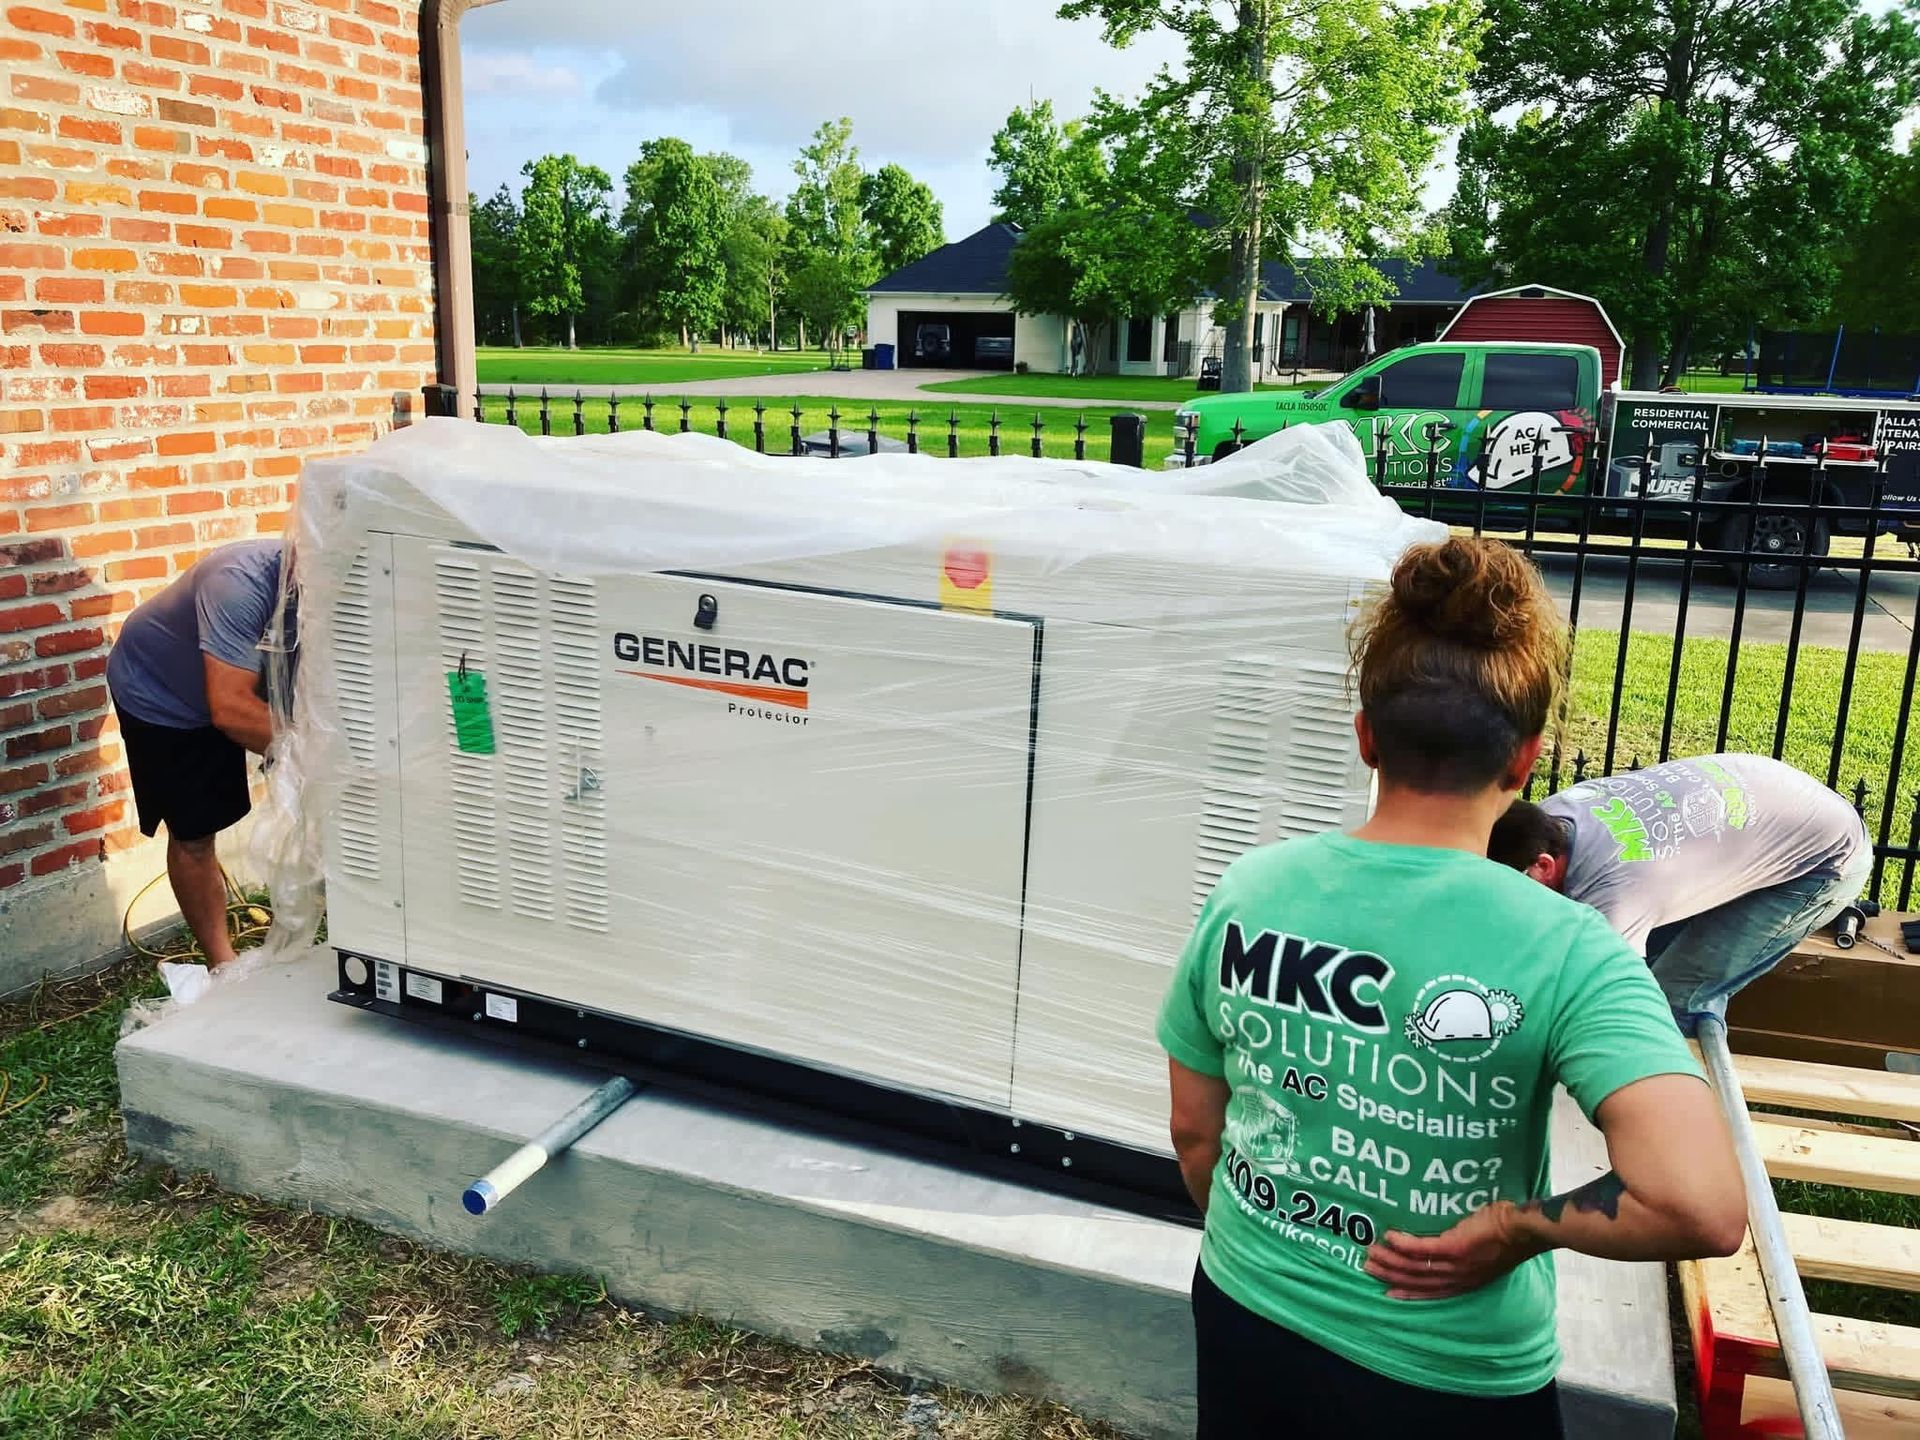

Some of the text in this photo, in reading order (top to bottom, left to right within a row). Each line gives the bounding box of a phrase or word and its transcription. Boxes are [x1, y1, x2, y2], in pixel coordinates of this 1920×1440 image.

[1514, 427, 1536, 440] AC
[1631, 419, 1709, 431] COMMERCIAL
[1634, 408, 1710, 420] RESIDENTIAL
[1881, 494, 1905, 502] ollow
[614, 632, 809, 687] GENERAC
[728, 703, 809, 726] Protector
[1590, 796, 1655, 863] MKC
[1219, 919, 1396, 1035] MKC
[1219, 1001, 1517, 1110] SOLUTIONS
[1281, 1066, 1329, 1102] AC
[1331, 1125, 1503, 1185] BAD AC?
[1309, 1155, 1399, 1208] CALL
